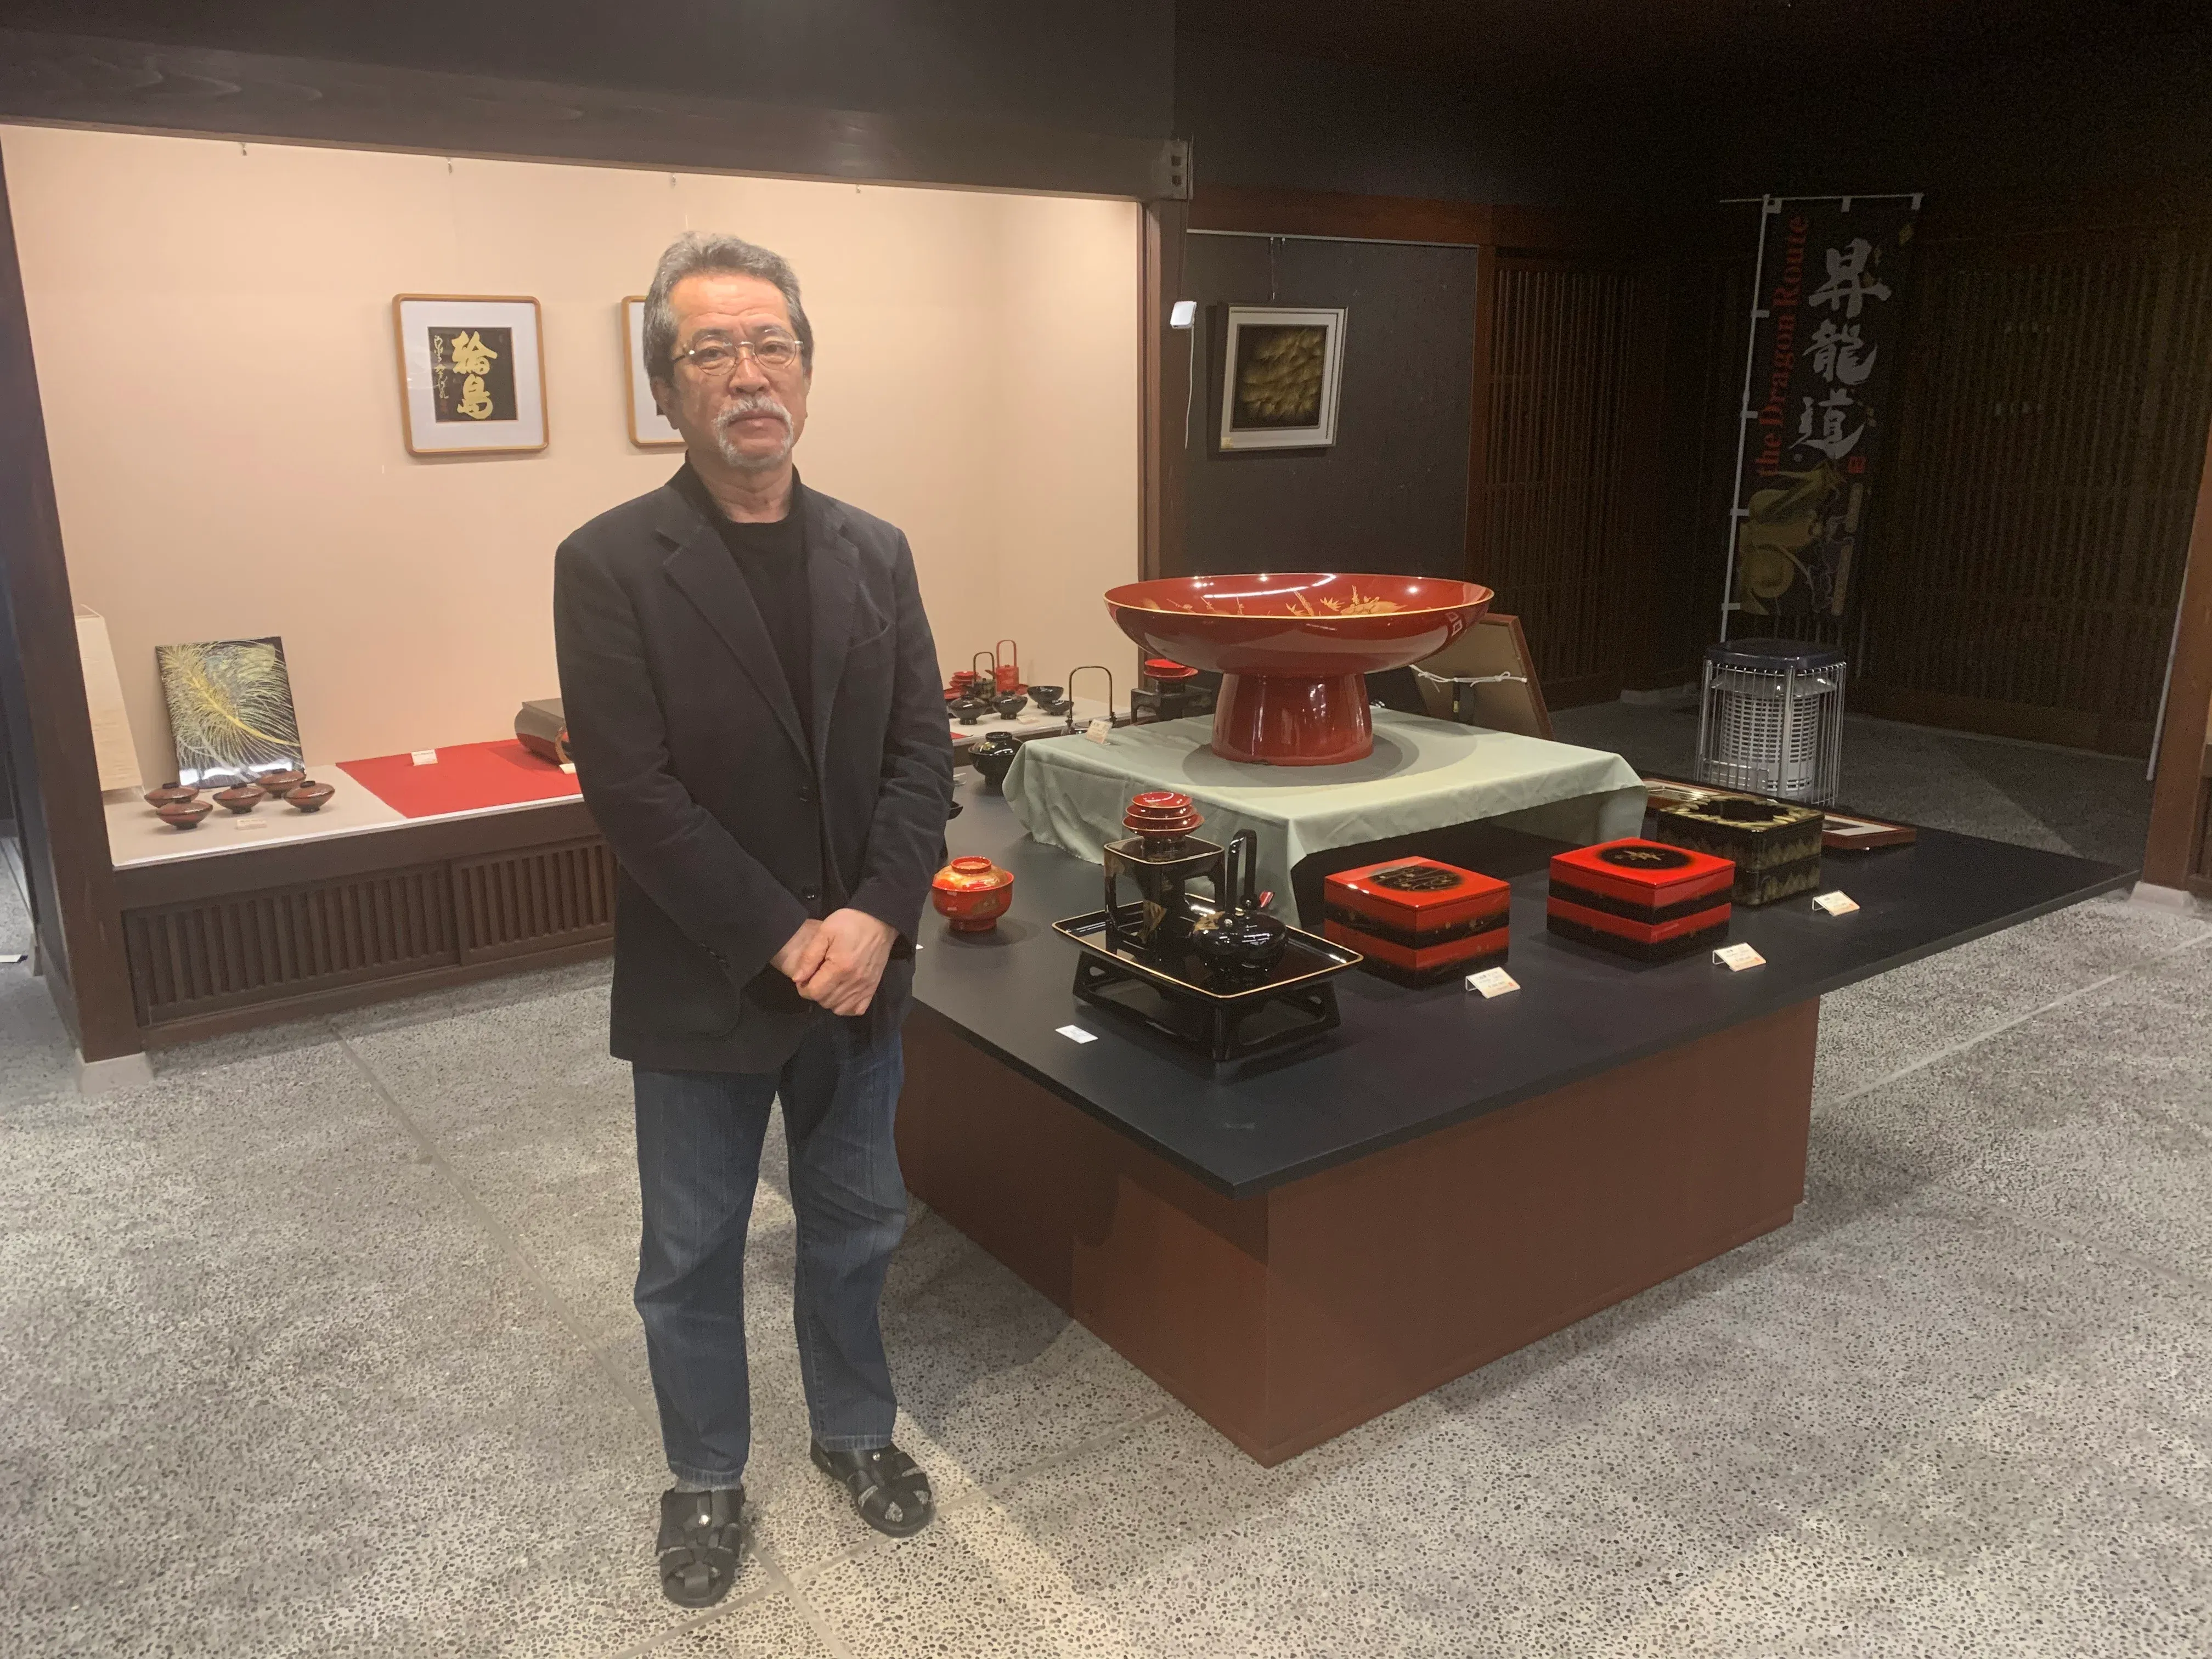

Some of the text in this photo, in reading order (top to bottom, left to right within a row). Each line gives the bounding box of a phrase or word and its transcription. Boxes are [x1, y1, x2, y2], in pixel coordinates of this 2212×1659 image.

[1771, 215, 1808, 307] Route
[451, 331, 498, 419] 輪島
[1759, 313, 1796, 426] Dragon
[1788, 238, 1892, 459] 昇龍道
